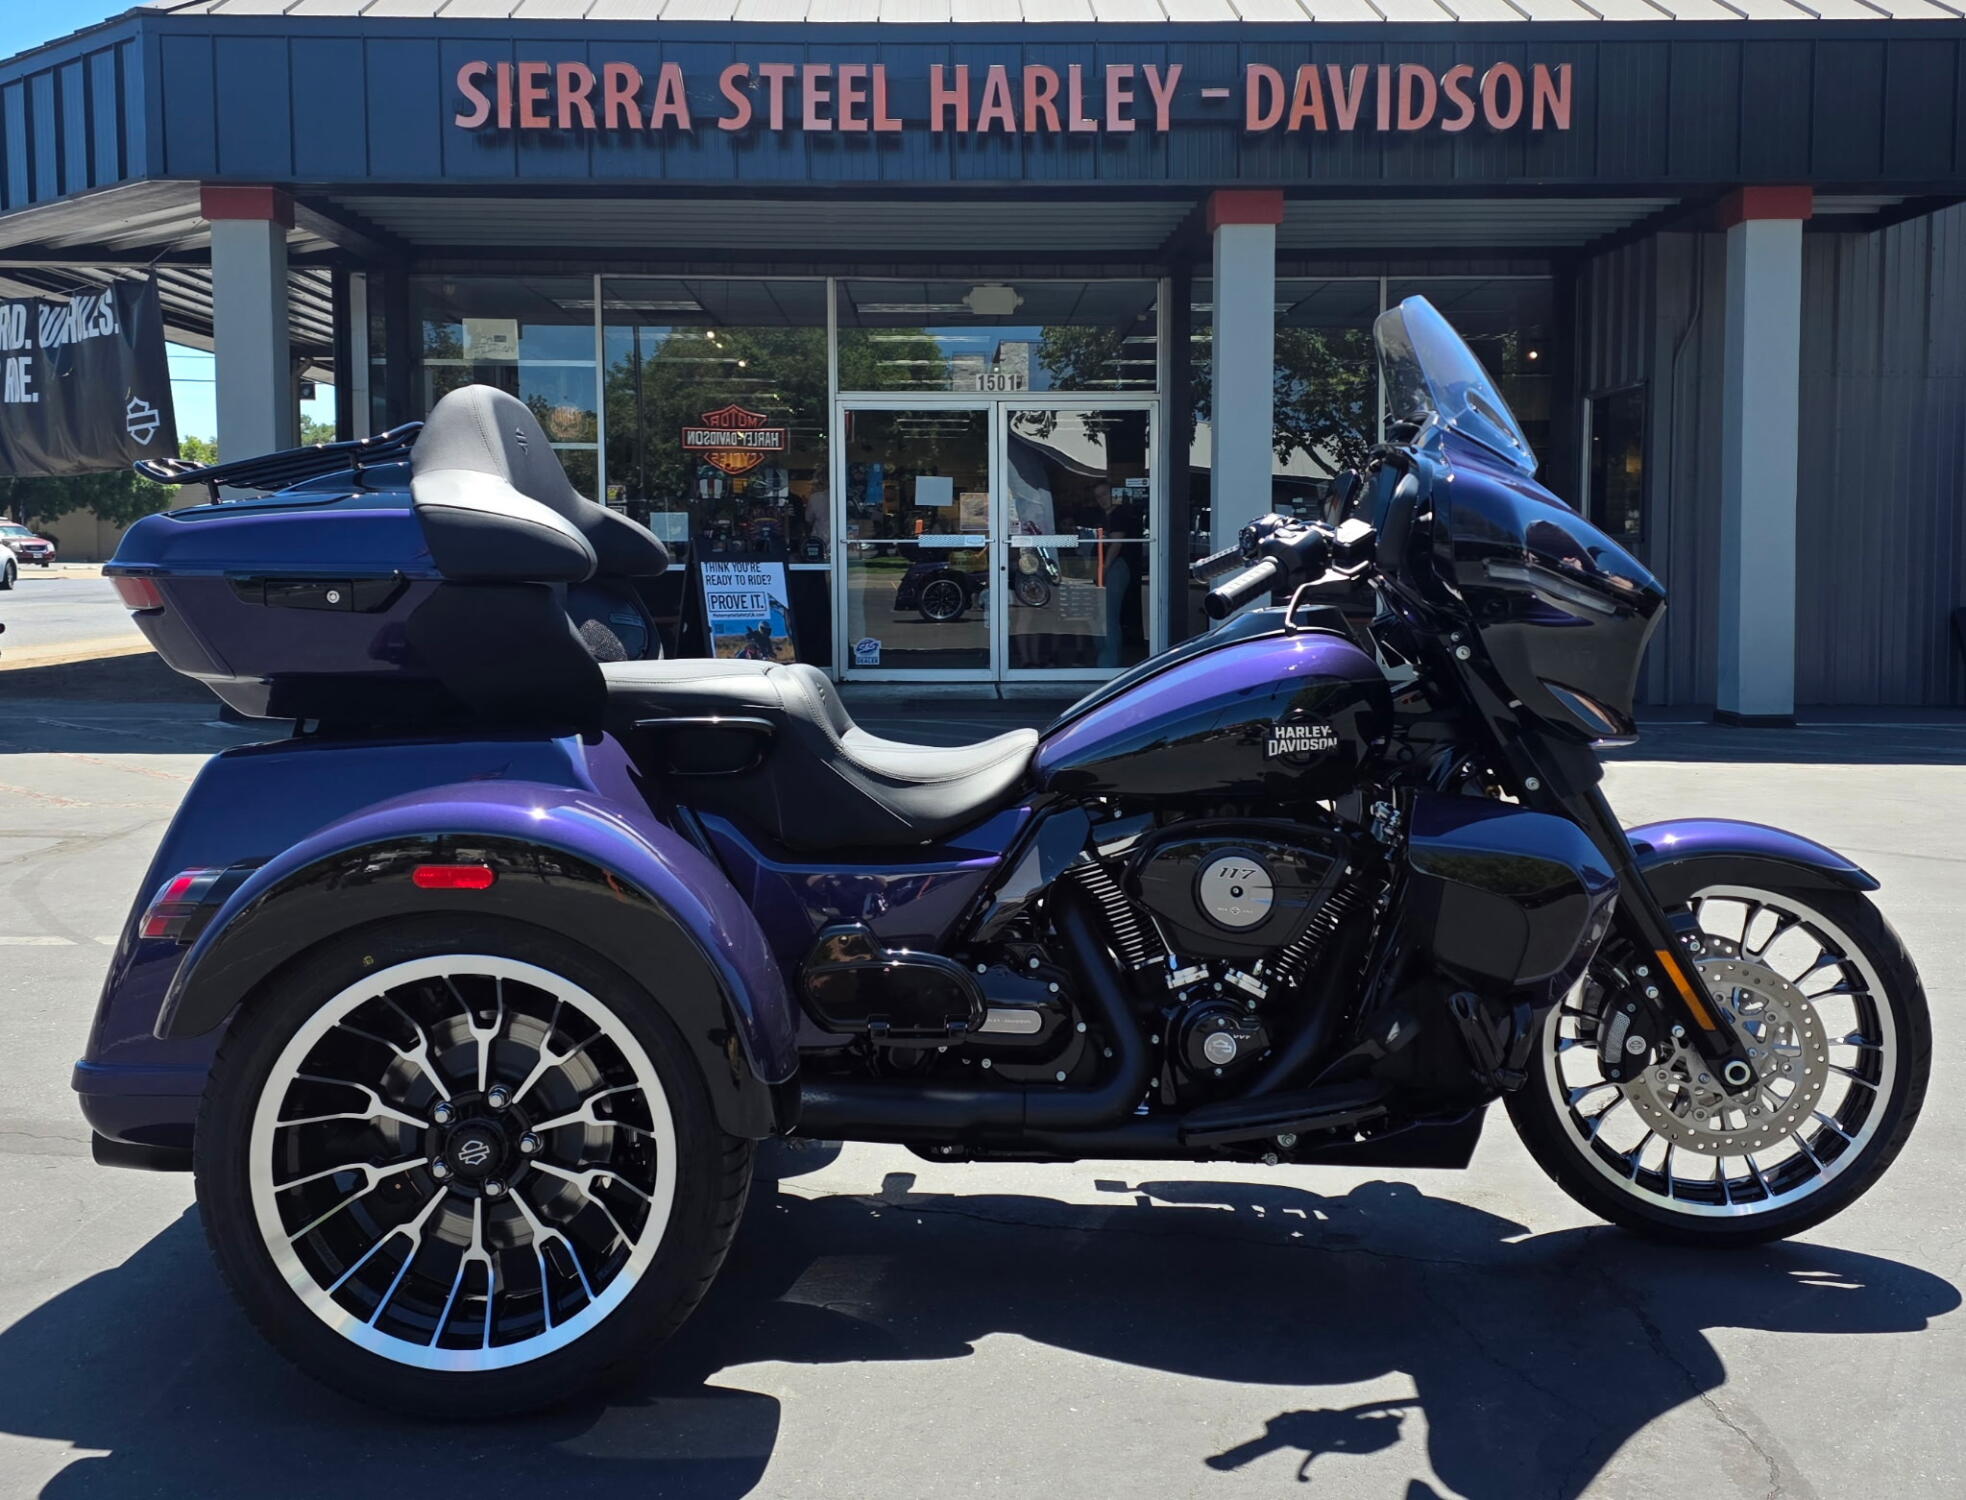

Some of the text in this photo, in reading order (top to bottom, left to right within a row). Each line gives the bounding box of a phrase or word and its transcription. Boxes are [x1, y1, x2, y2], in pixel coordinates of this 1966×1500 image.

[455, 61, 692, 129] SIERRA
[718, 62, 903, 131] STEEL
[704, 562, 762, 573] THINK YOU'RE
[706, 574, 771, 585] READY TO RIDE?
[710, 594, 764, 609] PROVE IT.
[1268, 737, 1338, 757] DAVIDSON
[1220, 867, 1257, 879] 117
